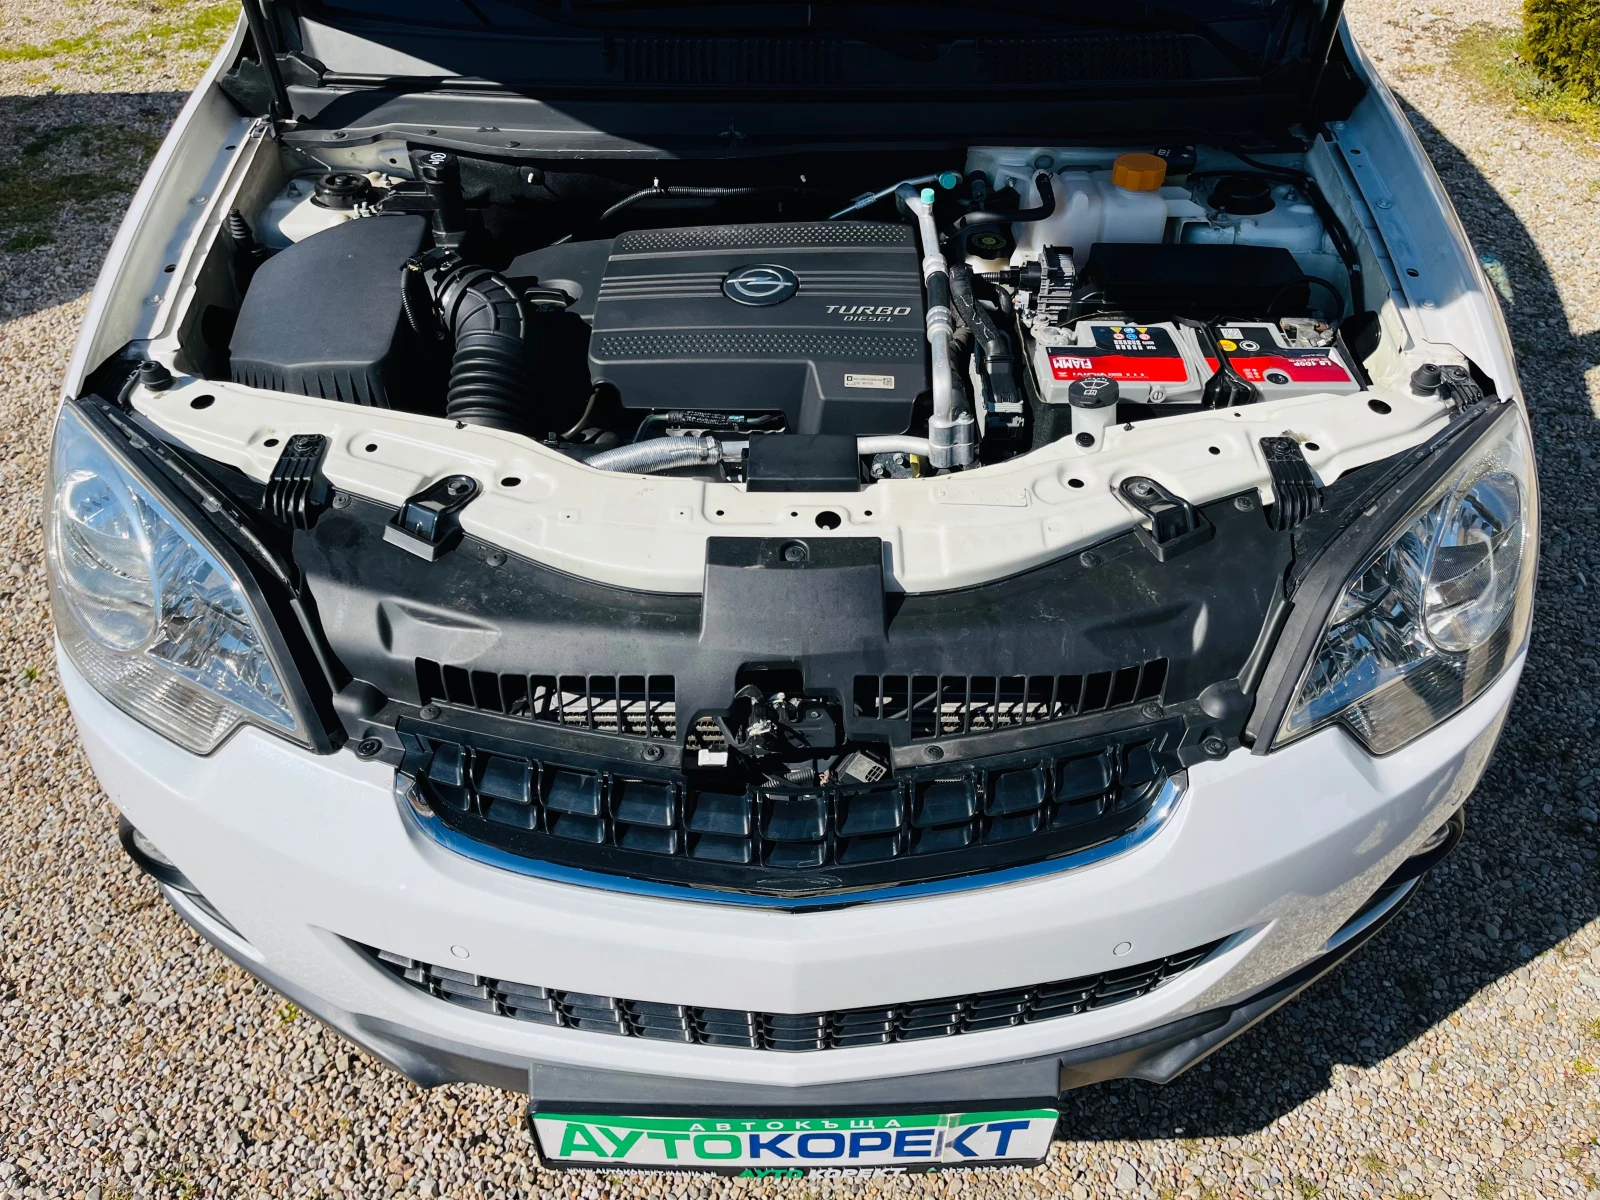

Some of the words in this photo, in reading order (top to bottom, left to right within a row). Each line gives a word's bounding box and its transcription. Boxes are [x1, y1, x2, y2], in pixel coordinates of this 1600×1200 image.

[825, 305, 912, 316] TURBO
[843, 315, 894, 323] DIESEL
[1053, 357, 1093, 369] FIAMM
[689, 1118, 902, 1132] АВТОКЪЩА
[559, 1120, 1031, 1160] АУТОКОРЕКТ
[738, 1168, 805, 1179] АУТО
[807, 1166, 908, 1178] КОРЕКТ
